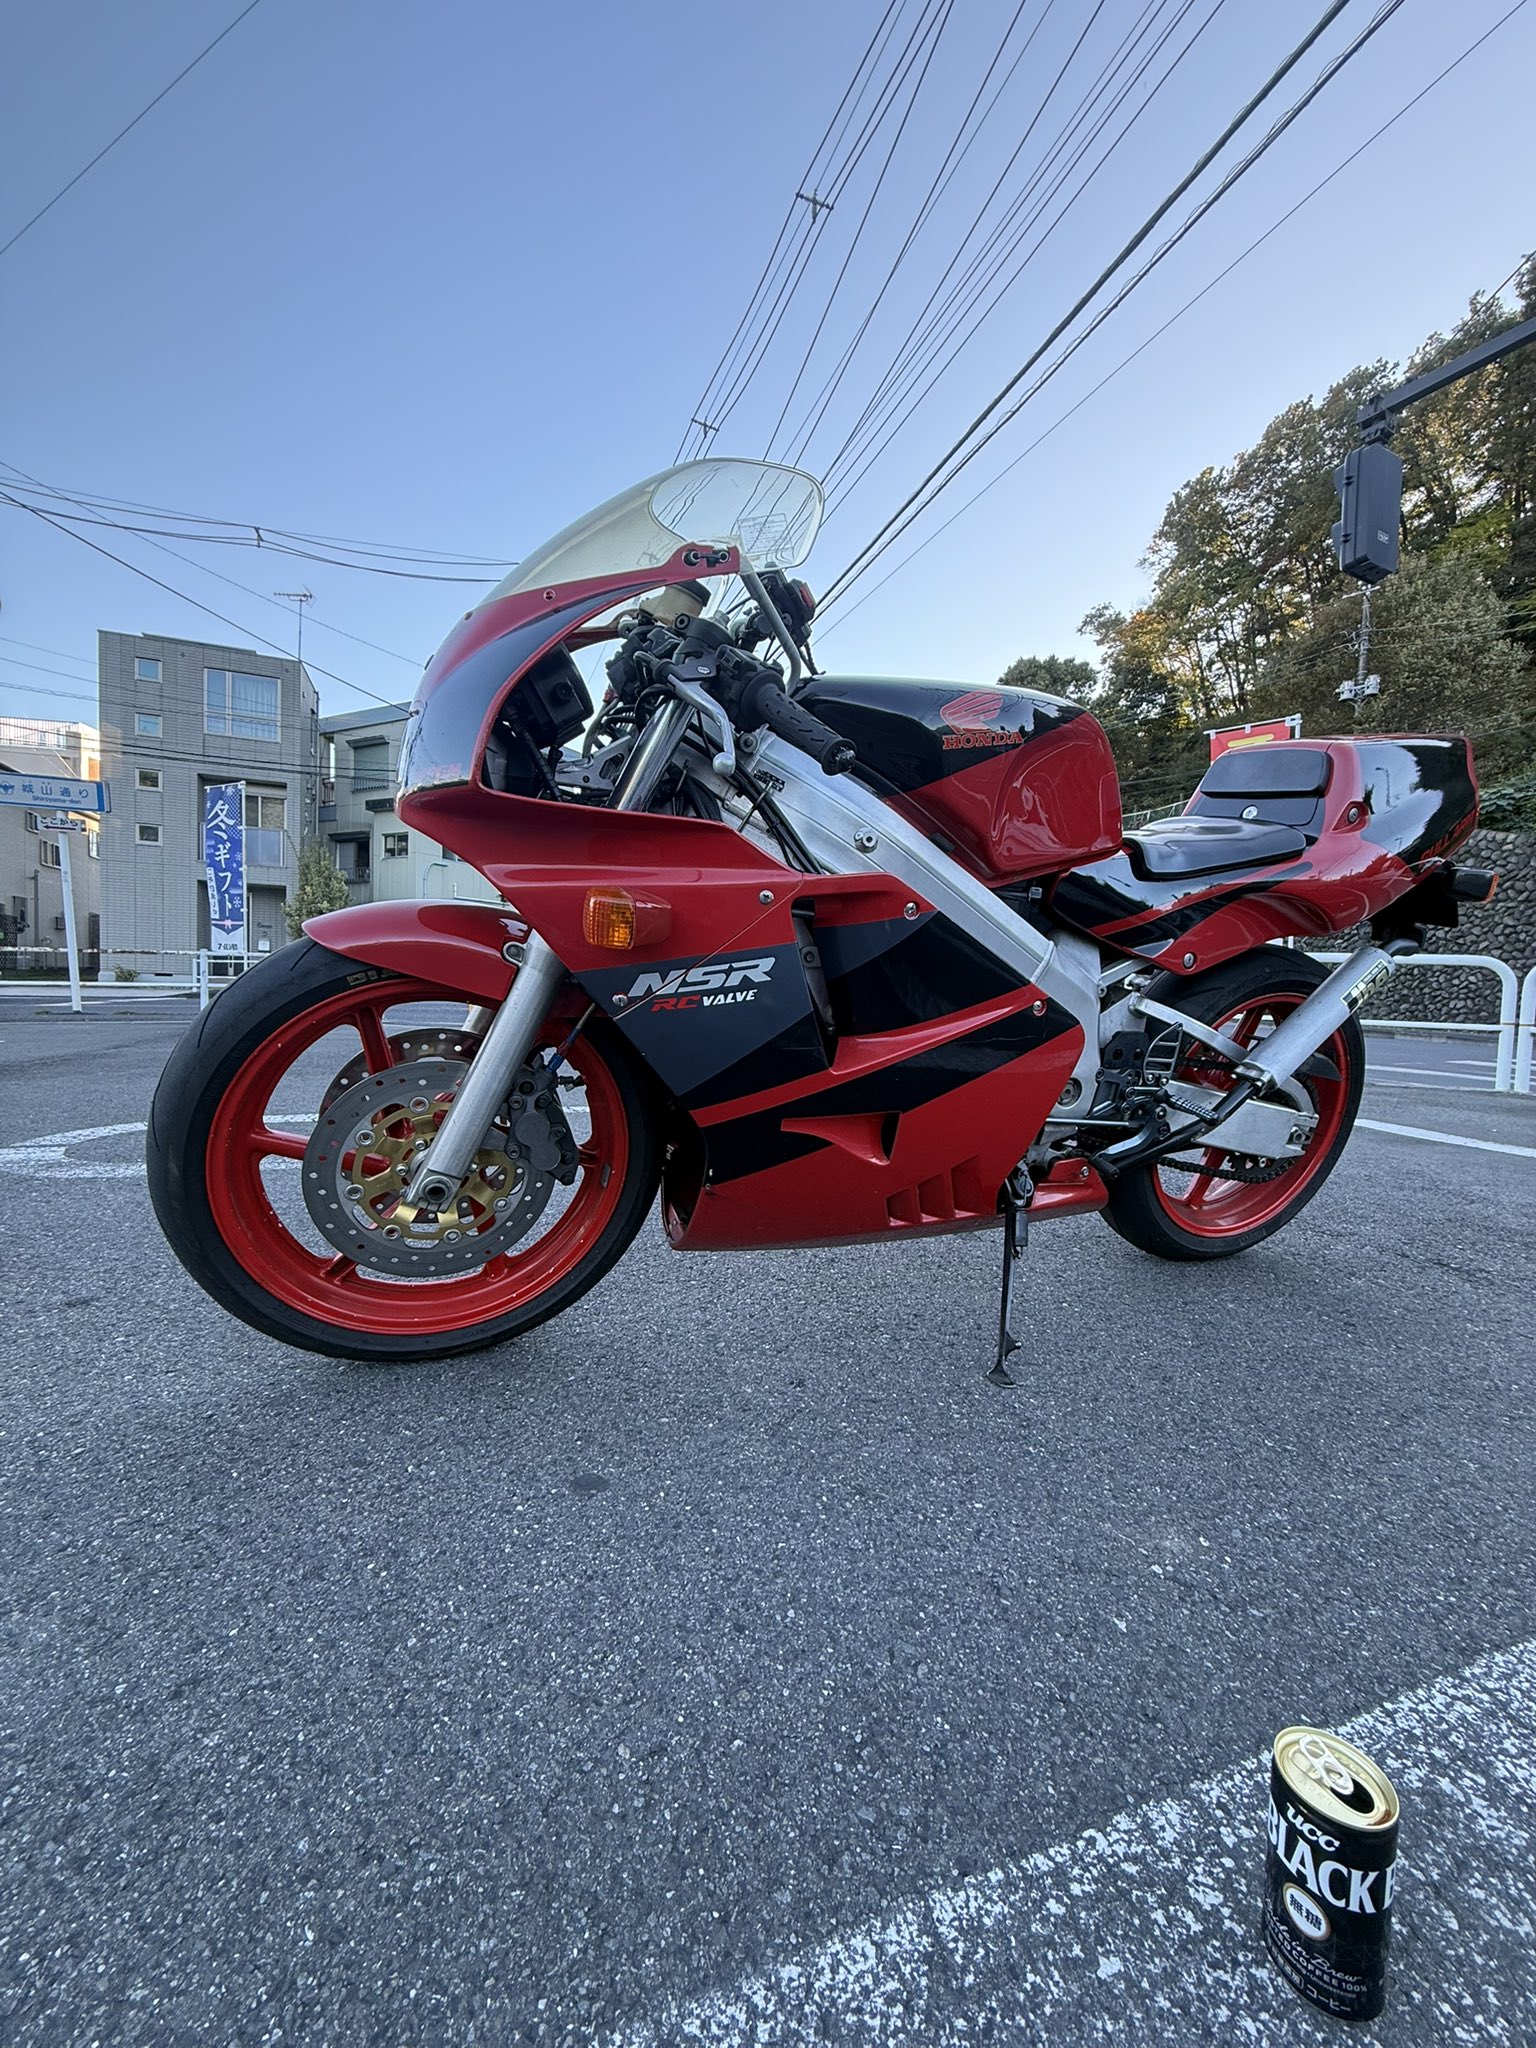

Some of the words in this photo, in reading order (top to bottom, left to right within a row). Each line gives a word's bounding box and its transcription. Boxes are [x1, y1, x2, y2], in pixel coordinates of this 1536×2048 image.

[943, 731, 1024, 750] HONDA
[41, 817, 79, 827] ここから
[207, 800, 237, 917] 冬ギフト
[627, 957, 776, 998] NSR
[651, 995, 701, 1012] RC
[702, 989, 758, 1007] VALVE
[1267, 1793, 1380, 1914] BLACK
[1289, 1893, 1323, 1932] 無糖
[1292, 1949, 1339, 1987] COFFEE
[1341, 1981, 1368, 1993] 100%
[1310, 1952, 1362, 1982] Brew
[1306, 1984, 1351, 2012] コーヒー
